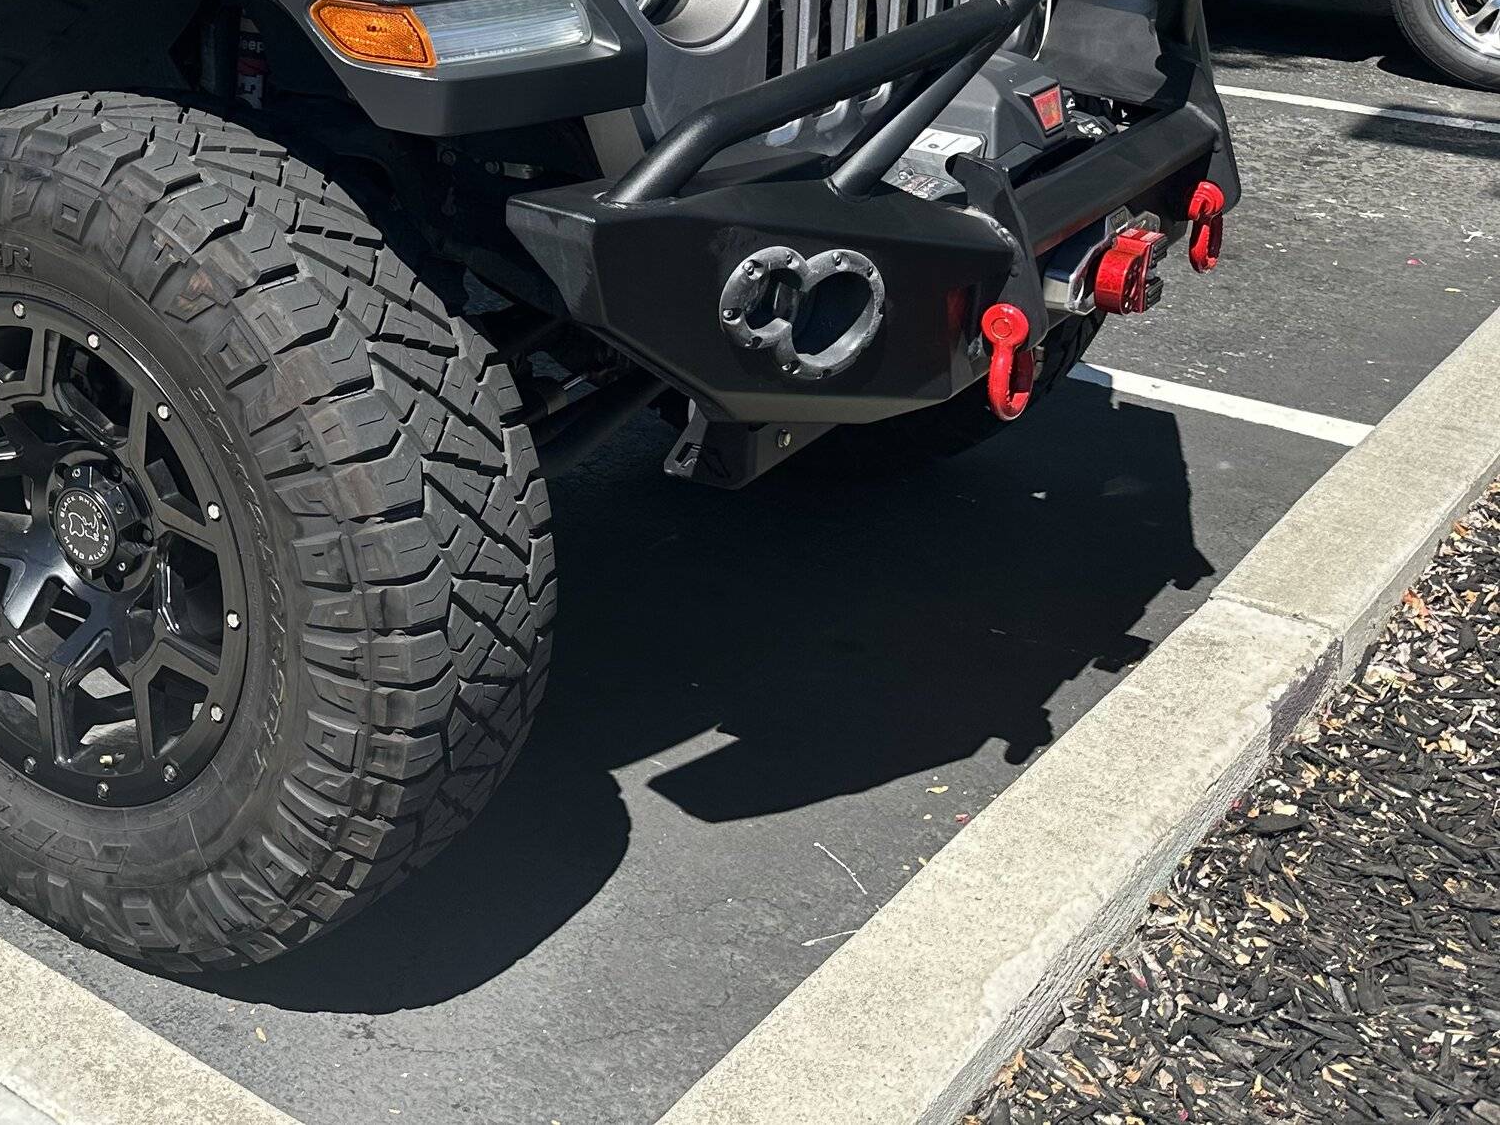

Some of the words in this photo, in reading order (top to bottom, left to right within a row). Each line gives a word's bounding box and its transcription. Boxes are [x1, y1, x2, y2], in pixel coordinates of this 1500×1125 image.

[59, 495, 76, 518] BLACK
[78, 495, 102, 519] RHINO
[63, 535, 85, 560] HARD
[88, 534, 110, 561] ALLOYS
